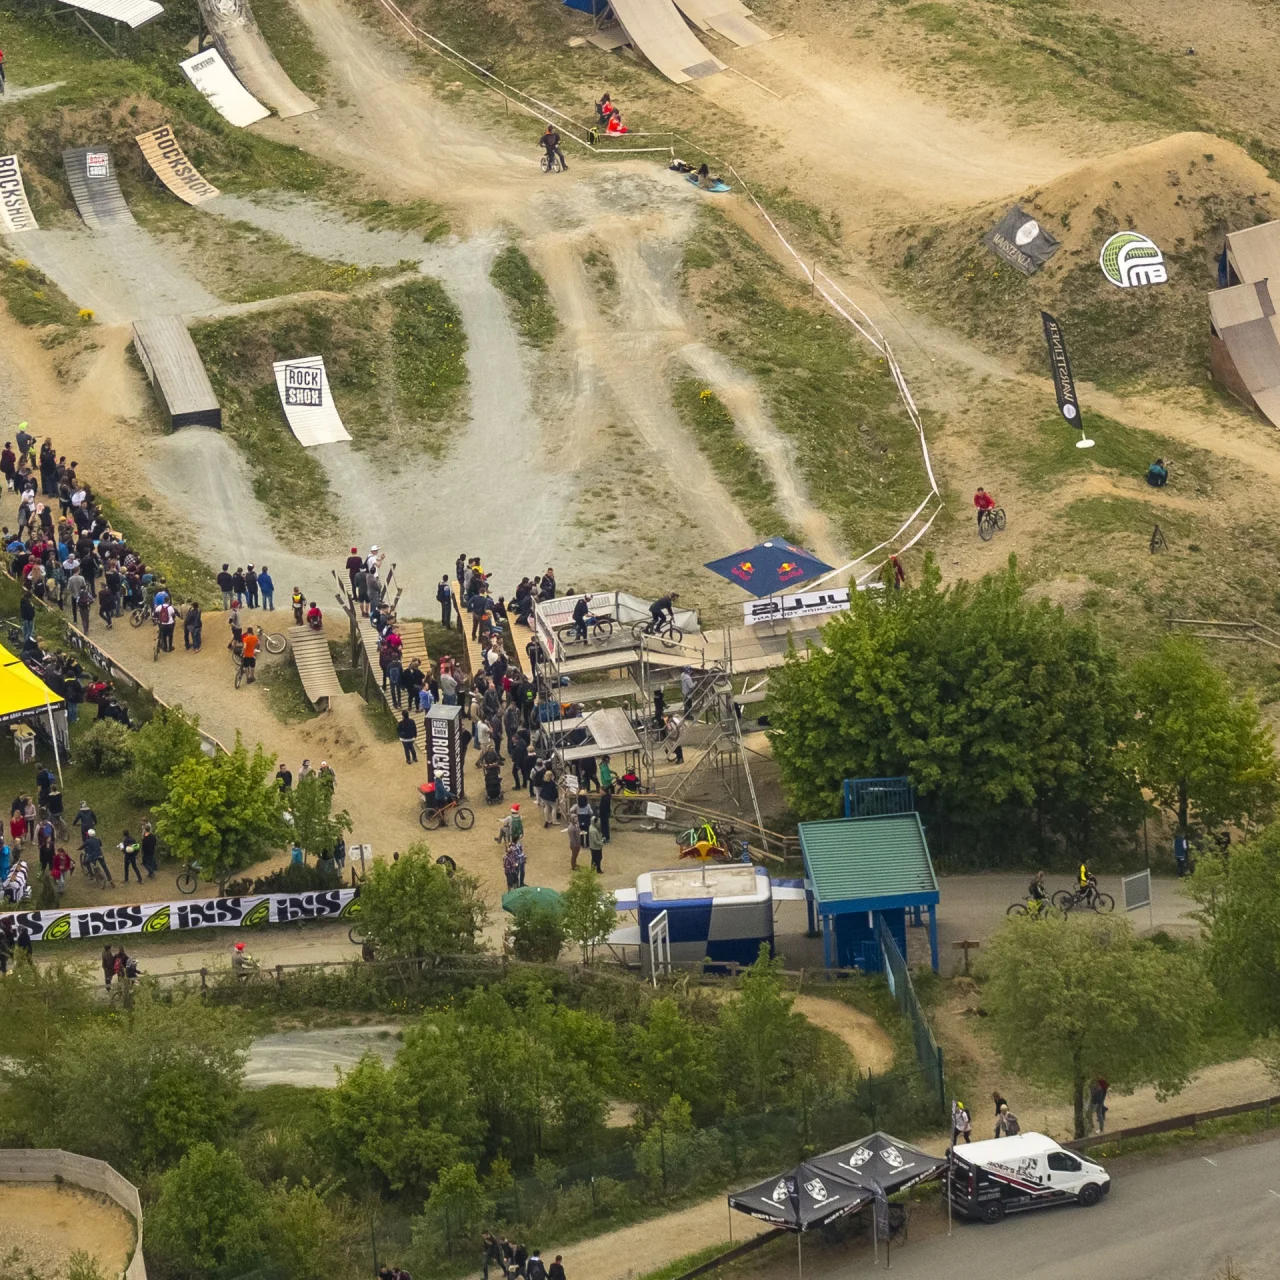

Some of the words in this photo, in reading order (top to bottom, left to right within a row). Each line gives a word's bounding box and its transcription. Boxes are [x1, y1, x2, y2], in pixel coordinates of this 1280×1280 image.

[152, 126, 216, 199] ROCKSHOX
[289, 370, 319, 387] ROCK
[288, 388, 320, 405] SHOX
